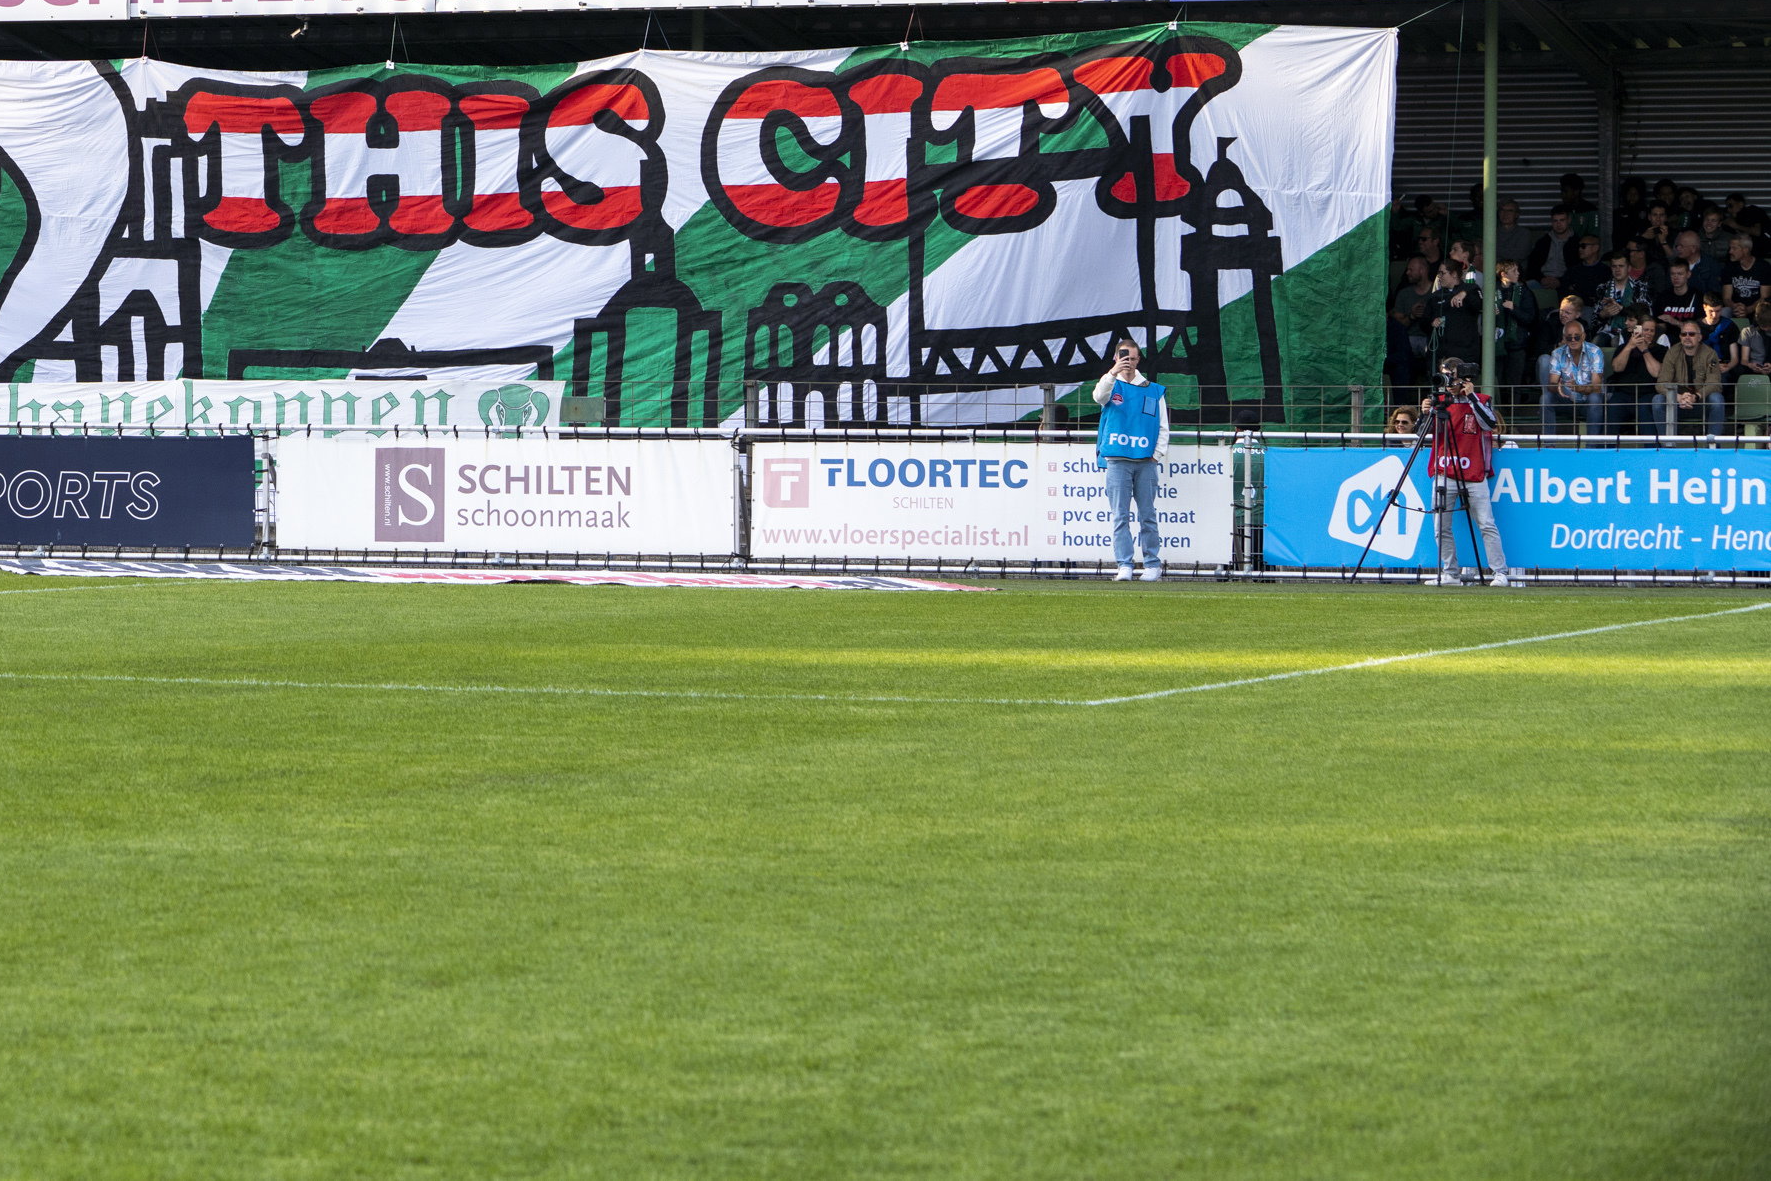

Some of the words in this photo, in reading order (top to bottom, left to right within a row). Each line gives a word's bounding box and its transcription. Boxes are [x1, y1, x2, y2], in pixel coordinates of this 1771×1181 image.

[165, 69, 669, 251] THIS
[701, 35, 1242, 244] CITY
[1109, 432, 1149, 448] FOTO
[820, 458, 1029, 489] FLOORTEC
[1063, 458, 1106, 473] schu
[1169, 459, 1224, 478] parket
[1434, 455, 1471, 470] OTO
[457, 464, 632, 496] SCHILTEN
[1491, 467, 1632, 504] Albert
[1649, 467, 1767, 515] Heijn
[384, 463, 392, 526] www.schilten.nl
[892, 496, 954, 510] SCHILTEN
[457, 500, 631, 528] schoonmaak
[1063, 510, 1092, 526] pvc
[762, 523, 1029, 550] www.vloerspecialist.nl
[1063, 531, 1112, 547] houte
[1550, 522, 1684, 551] Dordrecht
